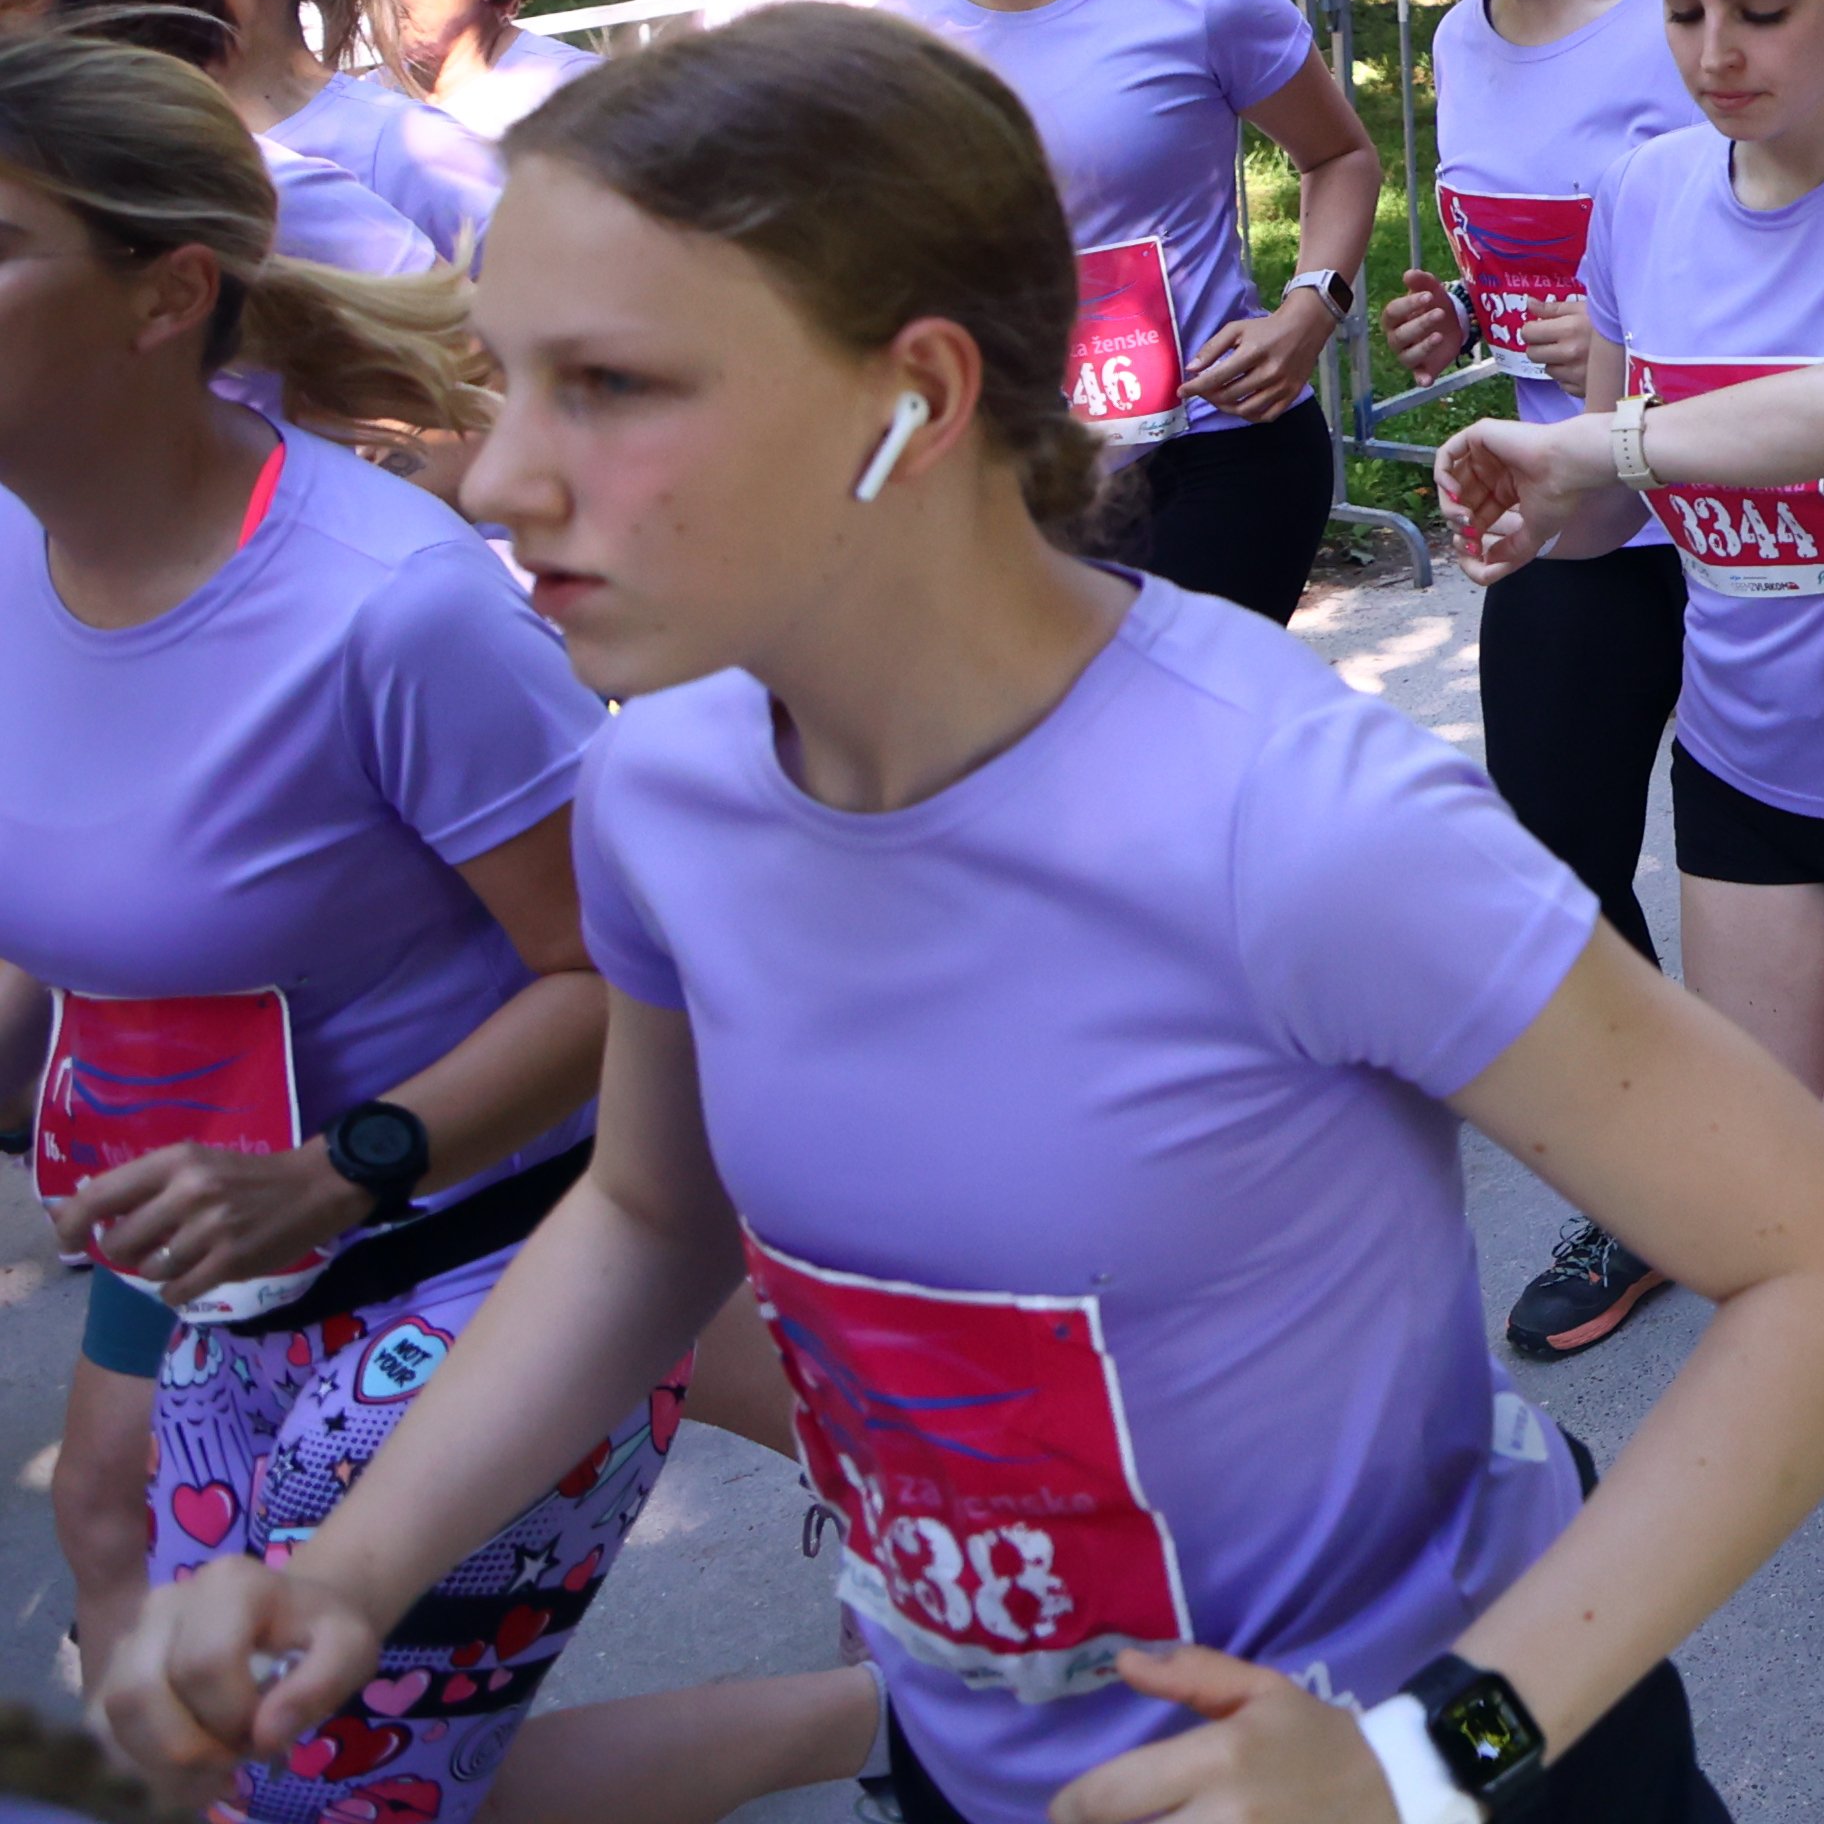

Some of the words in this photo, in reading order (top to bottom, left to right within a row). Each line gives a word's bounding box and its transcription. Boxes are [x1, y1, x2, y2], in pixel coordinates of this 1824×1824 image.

[1504, 272, 1530, 288] tek
[1533, 275, 1551, 288] za
[1091, 328, 1160, 355] ženske
[1072, 355, 1142, 416] 46
[1669, 492, 1819, 560] 3344
[373, 1348, 417, 1389] YOUR
[392, 1336, 434, 1368] NOT
[958, 1485, 1096, 1520] enske
[872, 1517, 1075, 1643] 38
